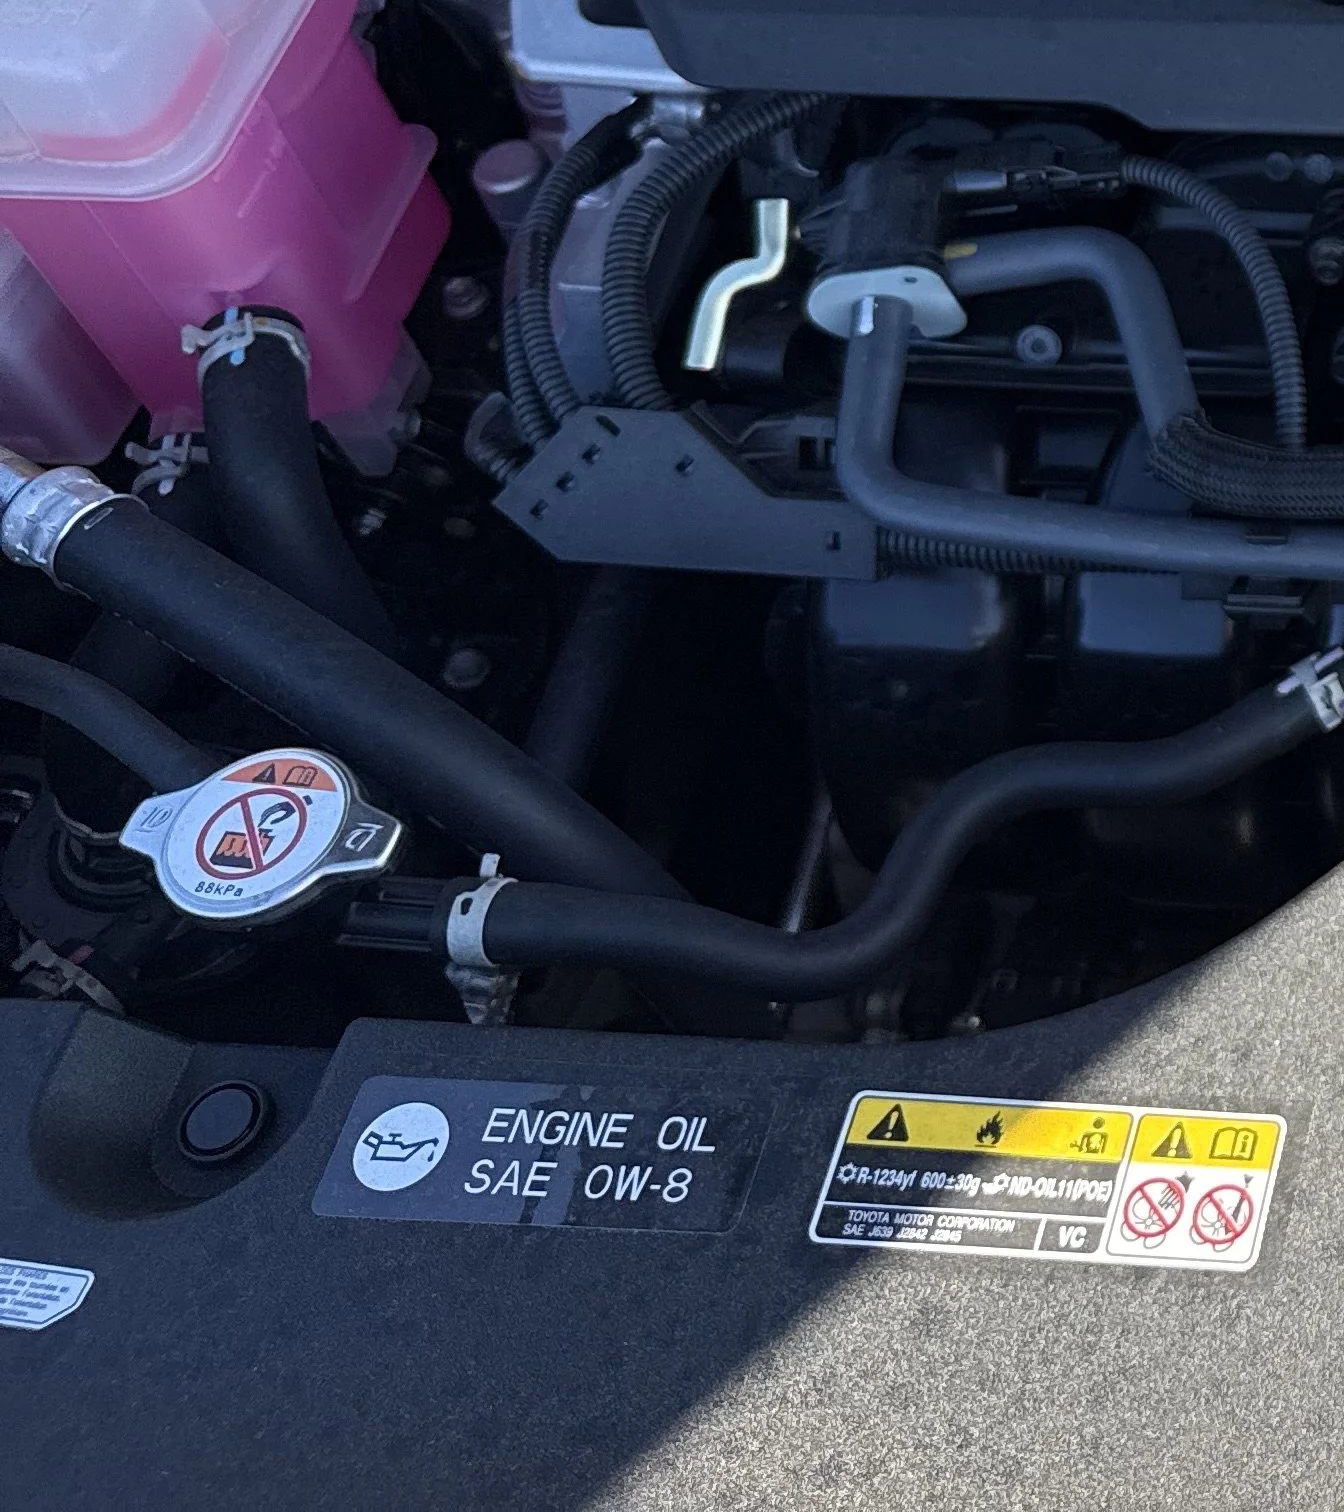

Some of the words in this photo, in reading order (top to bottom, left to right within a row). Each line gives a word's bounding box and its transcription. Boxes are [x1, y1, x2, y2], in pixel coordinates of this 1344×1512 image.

[194, 881, 244, 897] 88kPa
[481, 1107, 634, 1149] ENGINE
[656, 1116, 717, 1153] OIL
[464, 1159, 558, 1197] SAE
[584, 1164, 693, 1203] 0W-8
[857, 1166, 917, 1191] R-1234yf
[920, 1171, 981, 1197] 600±30g
[842, 1223, 865, 1236] SAE
[868, 1225, 894, 1238] J639
[848, 1209, 890, 1224] TOYOTA
[894, 1212, 935, 1227] MOTOR
[936, 1215, 1016, 1233] CORPORATION
[1058, 1225, 1087, 1248] VC
